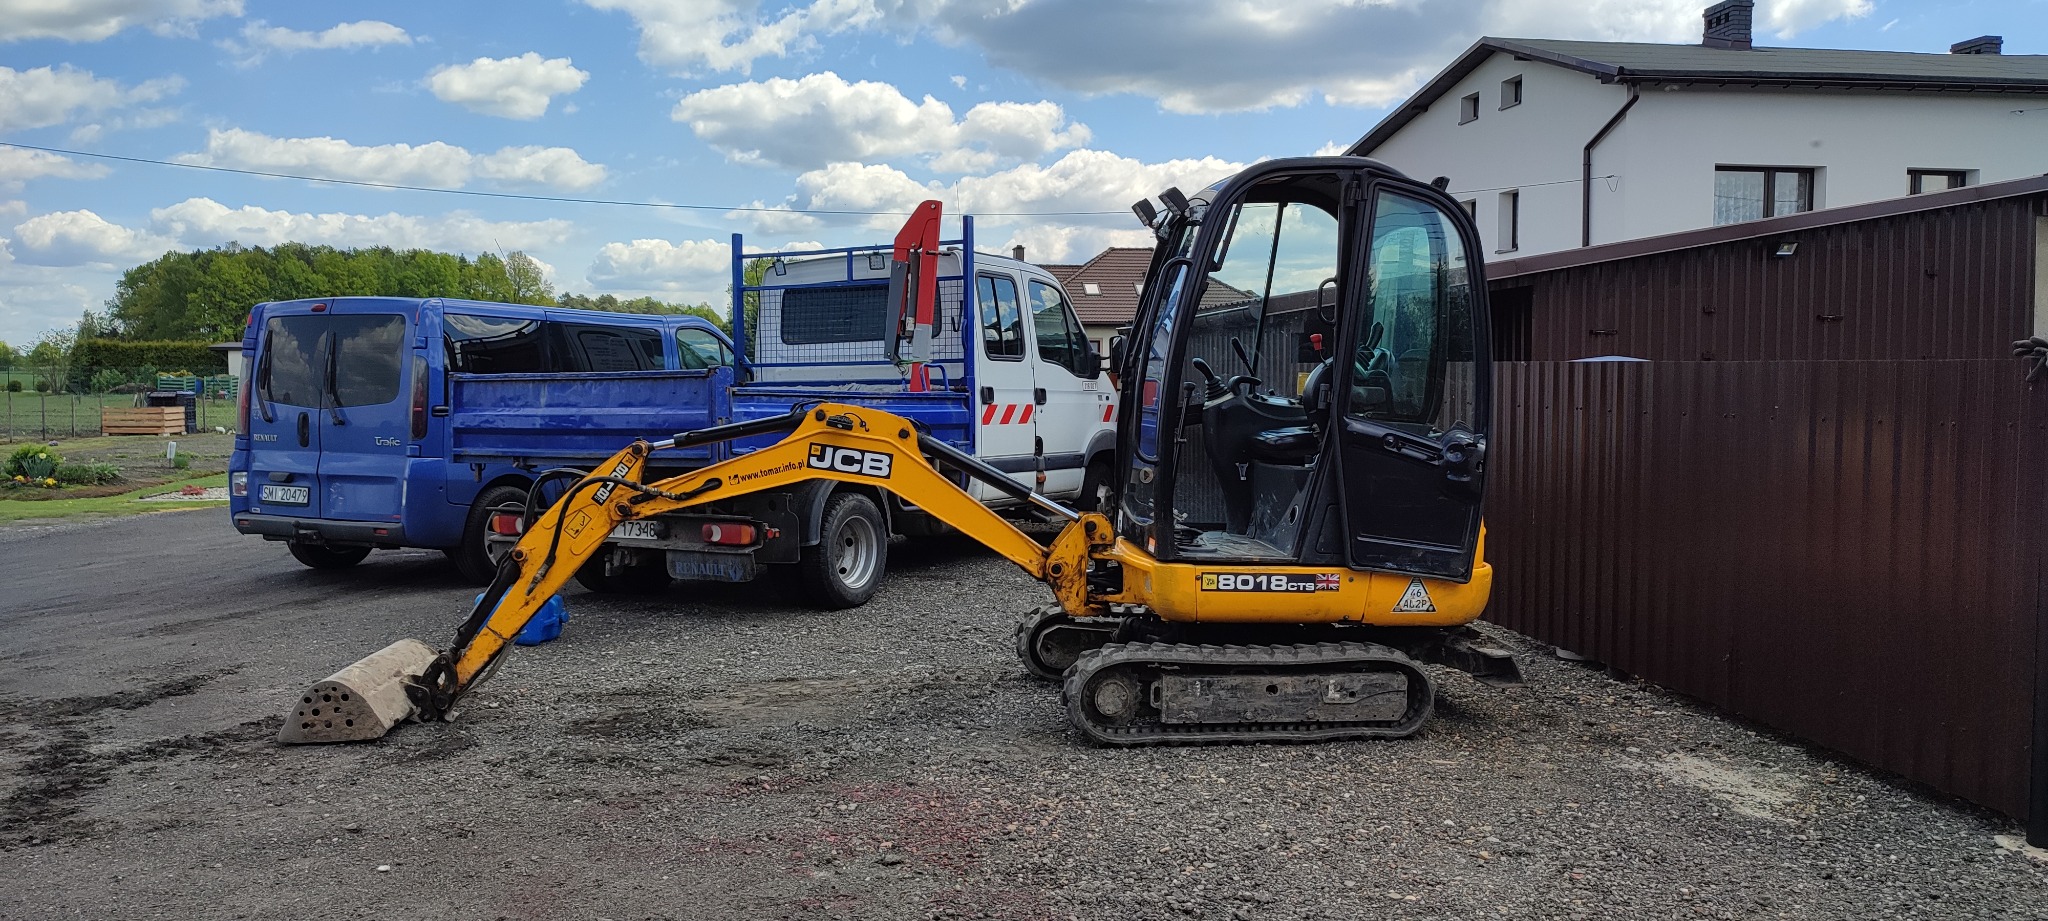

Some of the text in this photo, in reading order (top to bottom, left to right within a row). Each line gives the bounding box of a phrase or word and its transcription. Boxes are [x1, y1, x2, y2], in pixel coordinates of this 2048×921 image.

[374, 436, 401, 447] Trafic
[809, 446, 891, 477] JCB
[740, 459, 805, 482] www.tomar.info.pl
[263, 486, 308, 502] SMI 20479
[675, 561, 728, 577] RENAULT
